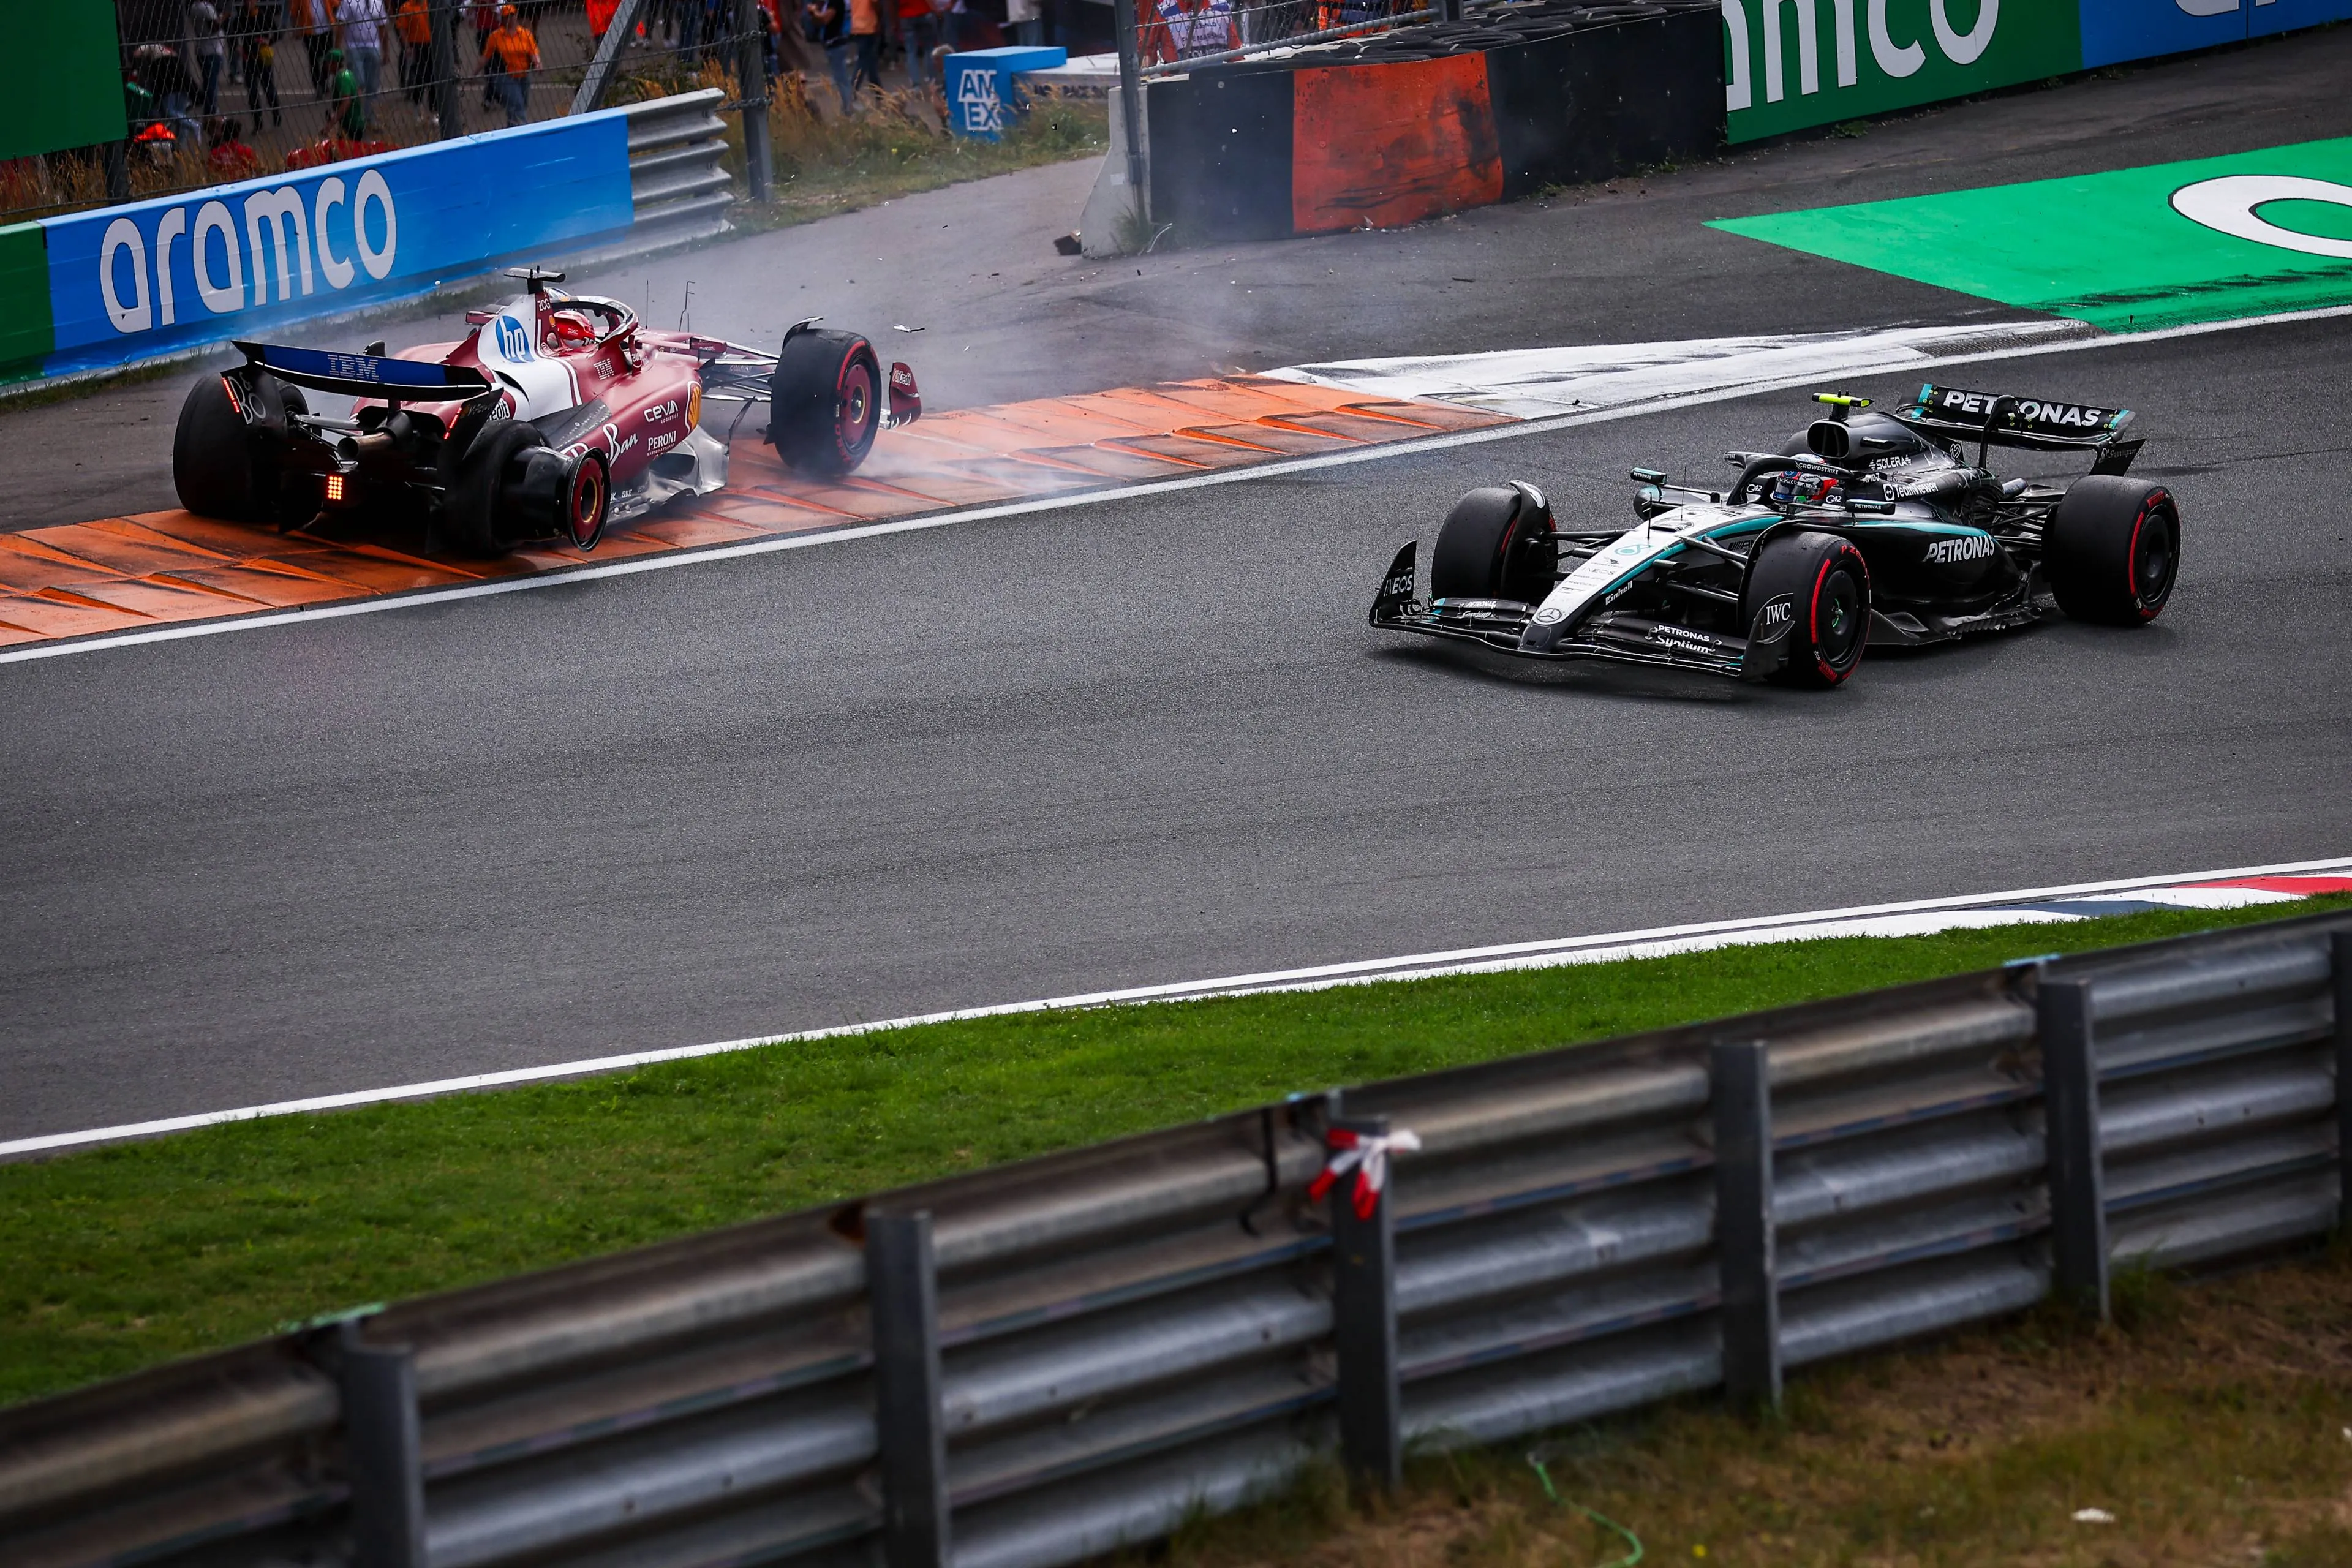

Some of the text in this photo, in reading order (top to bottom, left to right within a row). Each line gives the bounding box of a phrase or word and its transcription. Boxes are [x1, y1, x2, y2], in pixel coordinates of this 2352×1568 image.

[100, 169, 396, 334] aramco
[497, 315, 530, 363] hp
[328, 354, 380, 380] IBM
[594, 358, 614, 380] IBM
[648, 430, 677, 451] PERONI
[1798, 462, 1839, 475] CROWDSTRIKE
[1877, 455, 1907, 470] SOLERA
[1746, 484, 1763, 492] G42
[1826, 495, 1842, 503] G42
[1892, 481, 1939, 498] TeamViewer
[1923, 535, 1994, 563] PETRONAS
[1384, 574, 1413, 597] INEOS
[1605, 581, 1632, 606] Einhell
[1766, 602, 1792, 625] IWC
[1658, 625, 1709, 642] PETRONAS
